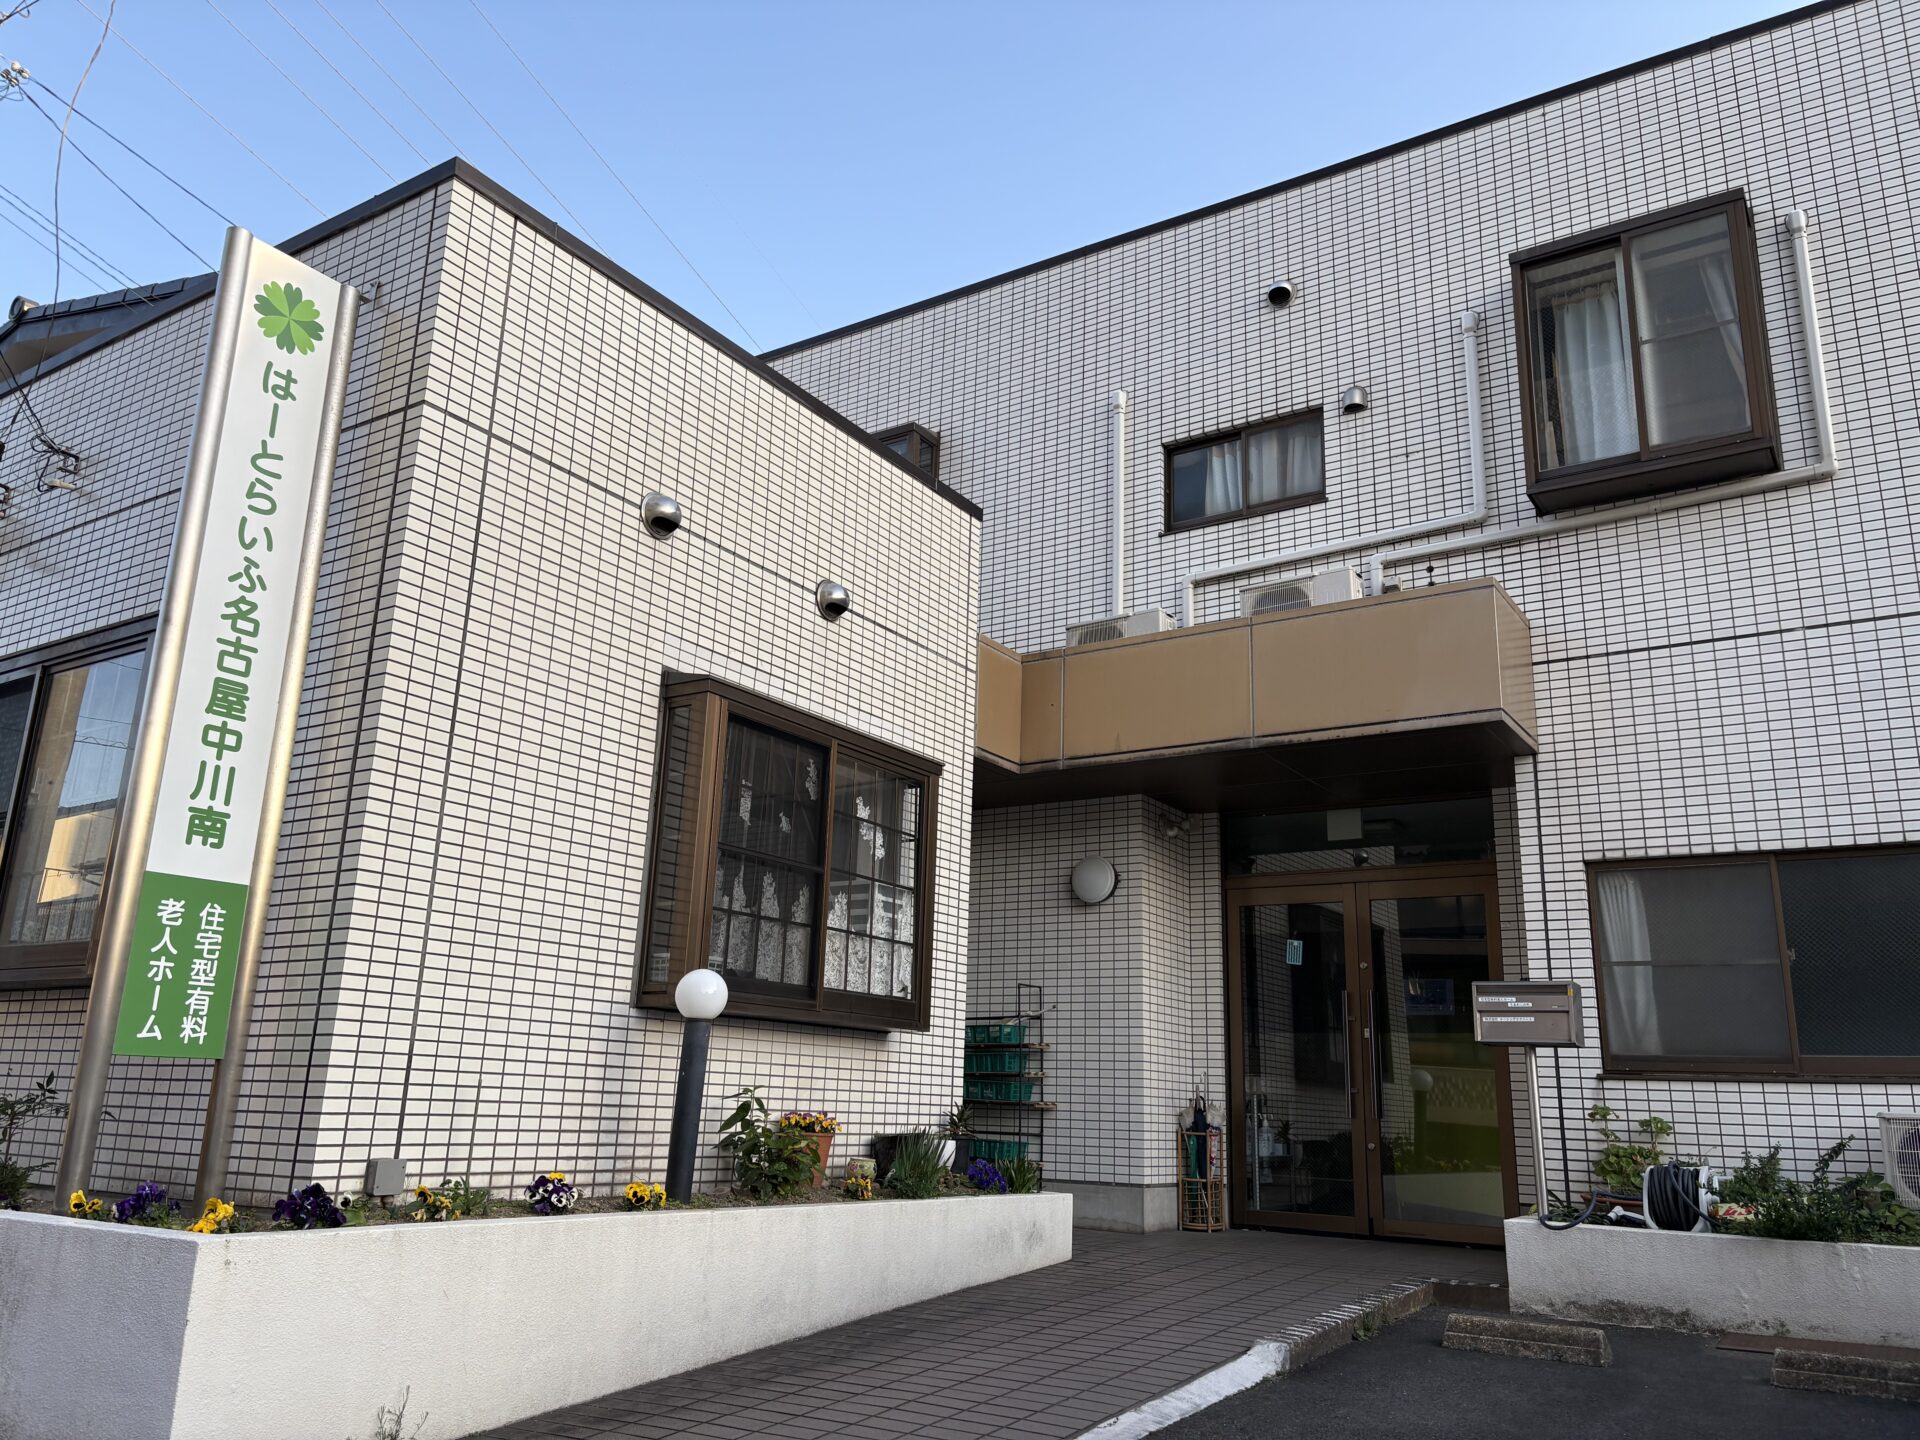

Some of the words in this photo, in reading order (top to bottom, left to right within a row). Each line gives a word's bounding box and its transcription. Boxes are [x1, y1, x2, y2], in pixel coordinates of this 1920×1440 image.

[185, 361, 298, 850] はーとらいふ名古屋中川南
[136, 897, 186, 1041] 老人ホーム
[180, 902, 227, 1045] 住宅型有料
